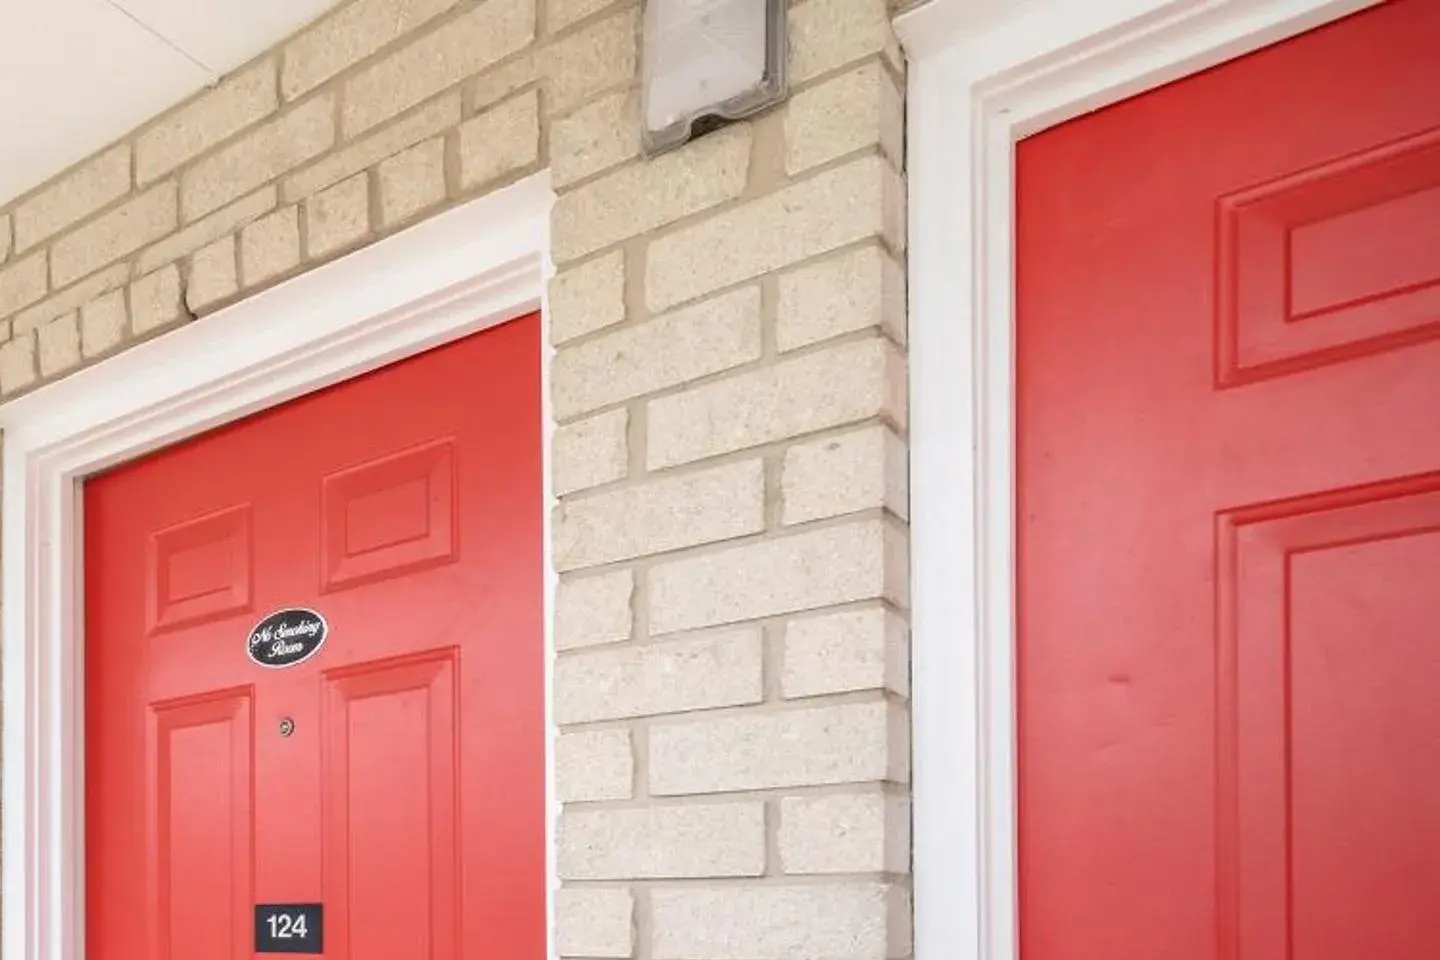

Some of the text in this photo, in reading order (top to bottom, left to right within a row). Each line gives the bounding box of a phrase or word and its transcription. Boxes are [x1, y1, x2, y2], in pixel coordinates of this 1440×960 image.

[252, 620, 321, 644] No Smoking
[266, 913, 308, 938] 124
